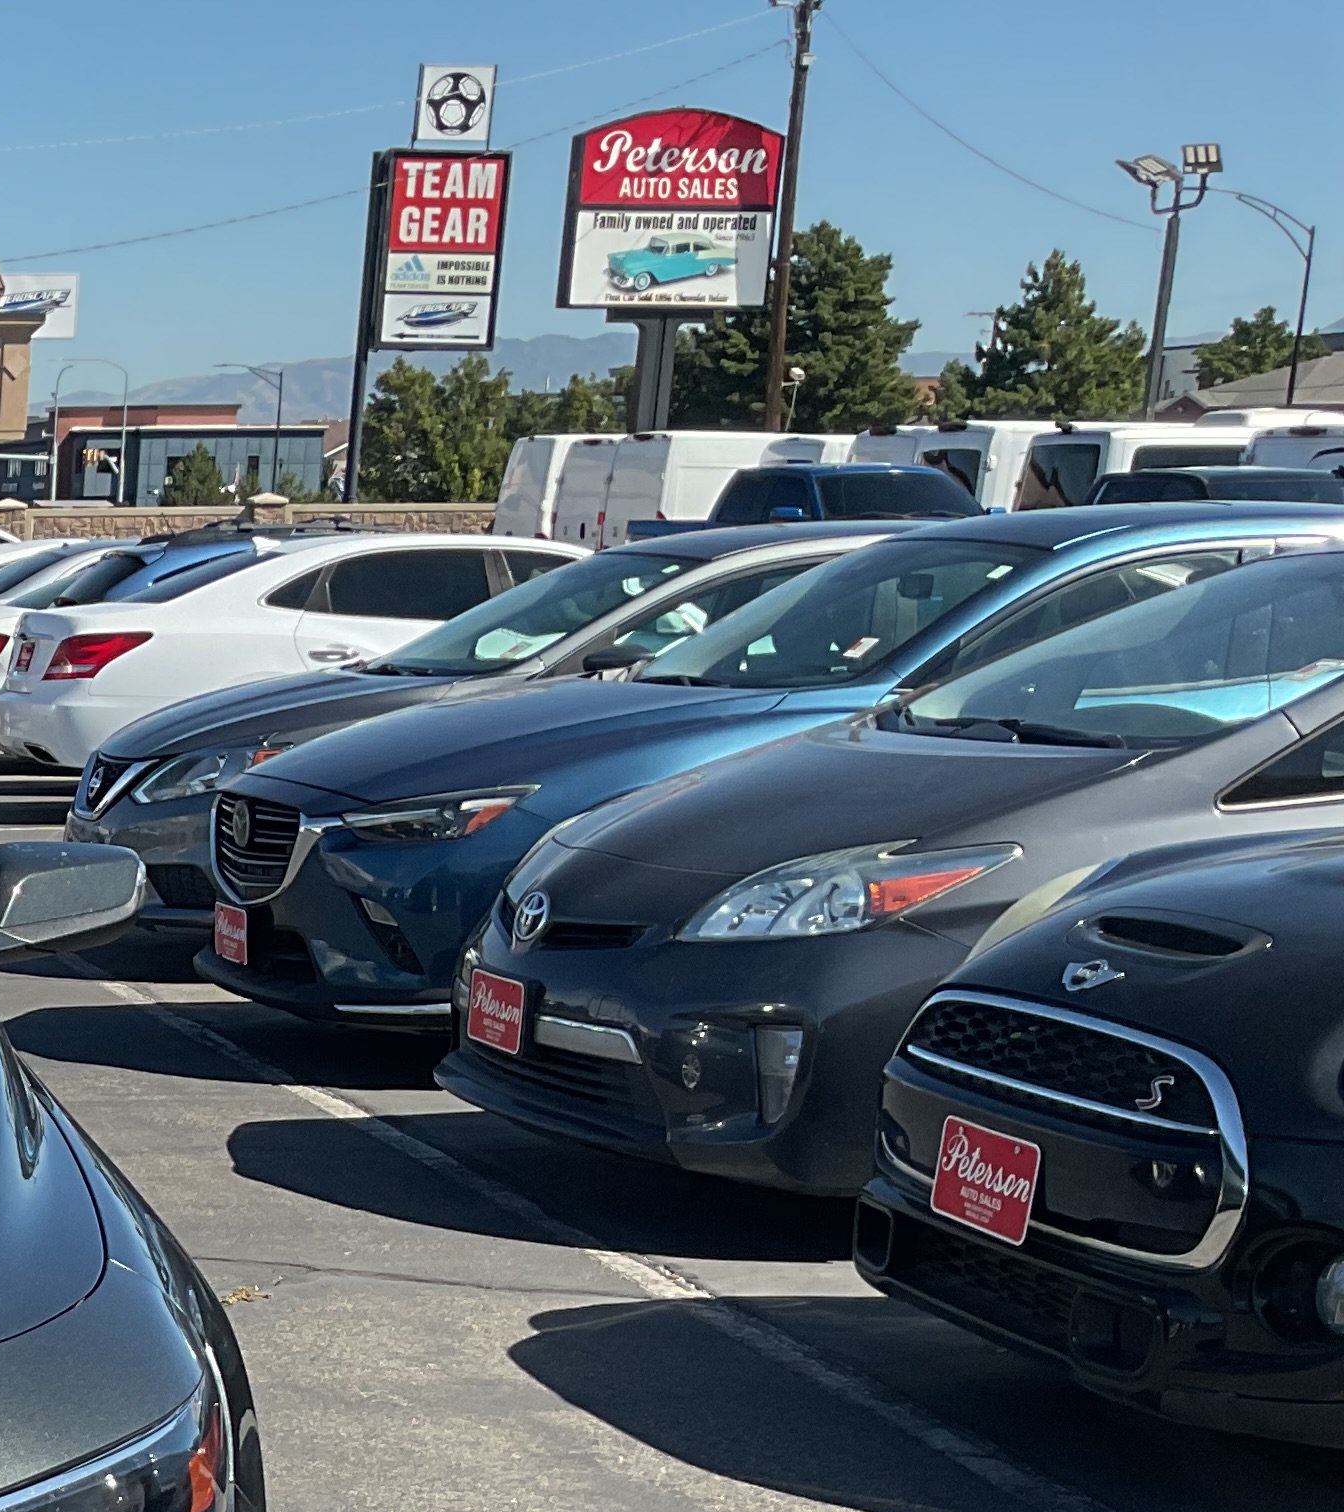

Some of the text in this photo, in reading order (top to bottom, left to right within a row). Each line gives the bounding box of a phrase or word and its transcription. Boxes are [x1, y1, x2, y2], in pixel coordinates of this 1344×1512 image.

[592, 129, 769, 174] Peterson
[402, 162, 498, 199] TEAM
[619, 177, 739, 199] AUTO SALES
[398, 206, 489, 244] GEAR
[593, 212, 758, 233] Family owned and operated
[437, 261, 490, 271] IMPOSSIBLE
[437, 275, 487, 286] IS NOTHING
[473, 981, 520, 1024] Peterson
[941, 1133, 1030, 1203] Peterson
[959, 1185, 979, 1202] AUTO
[978, 1192, 1002, 1212] SALES
